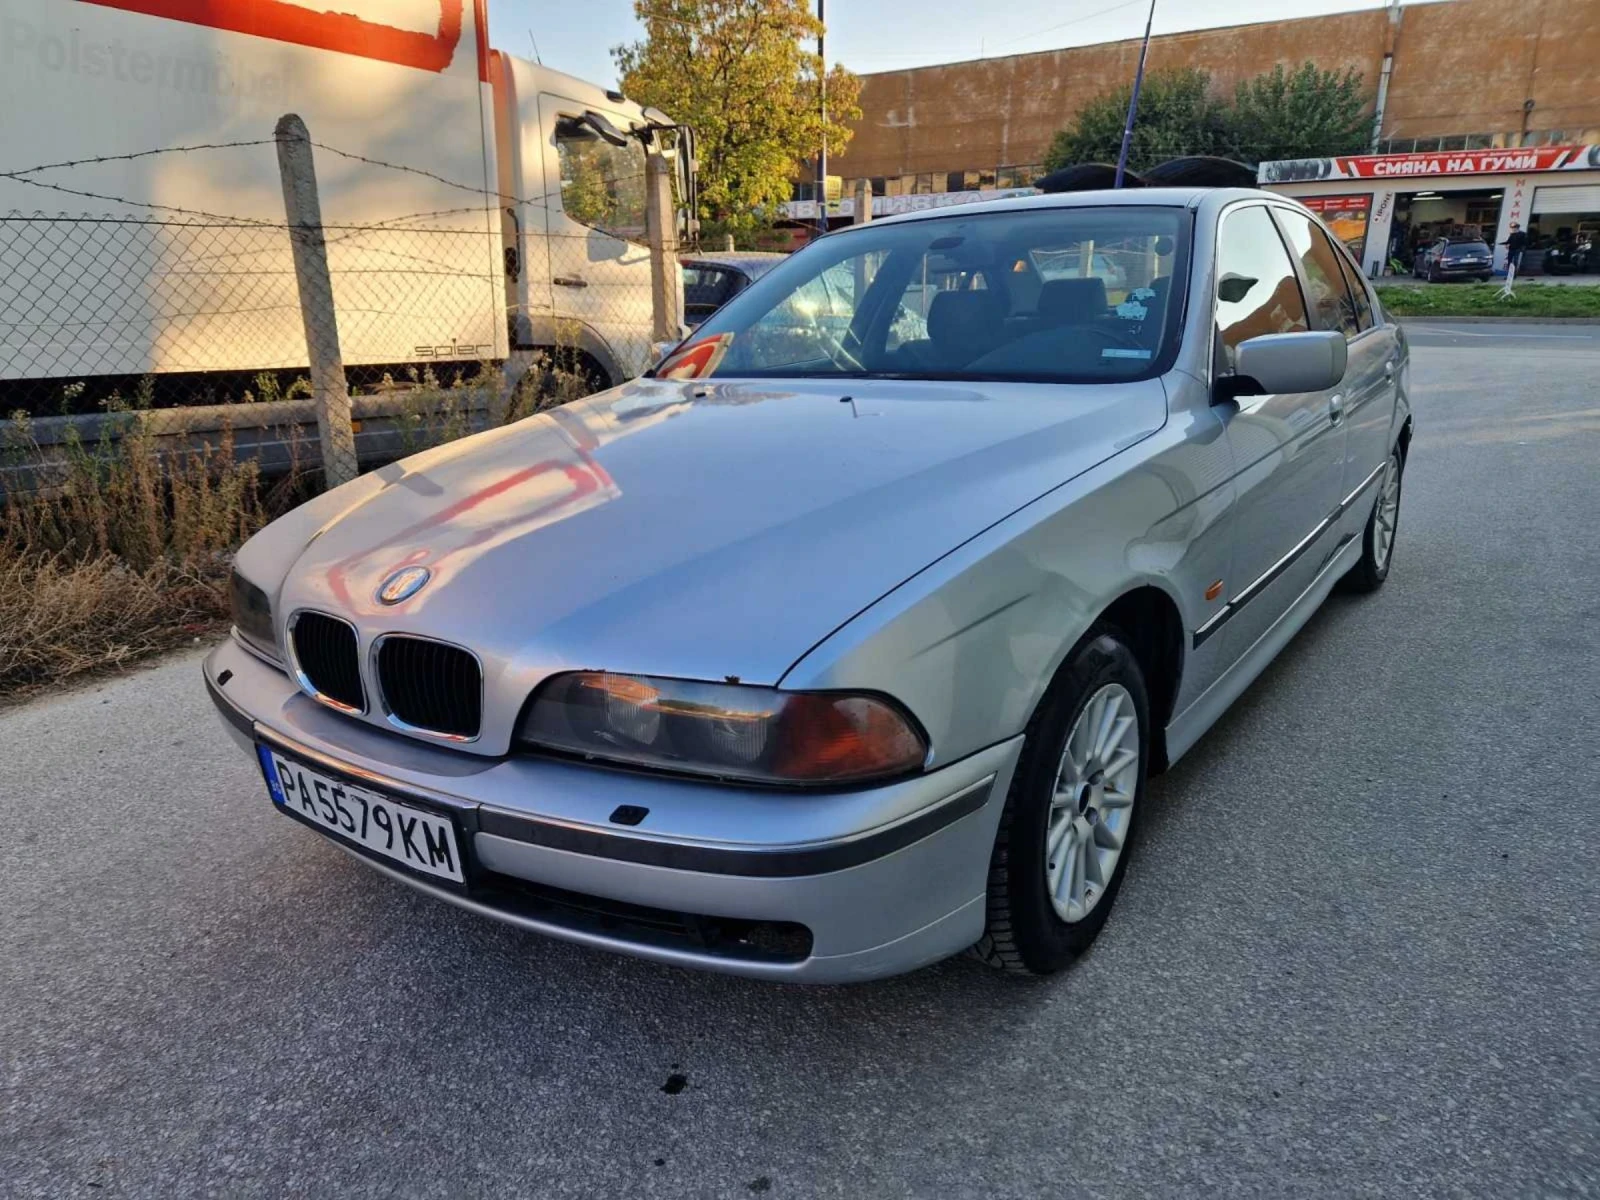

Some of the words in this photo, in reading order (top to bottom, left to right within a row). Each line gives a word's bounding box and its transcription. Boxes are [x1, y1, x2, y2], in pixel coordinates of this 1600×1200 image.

[1373, 158, 1440, 176] СМЯНА
[1446, 157, 1475, 173] НА
[1480, 154, 1538, 171] ГУМИ
[414, 337, 492, 359] spier
[276, 761, 454, 872] PA5579KM
